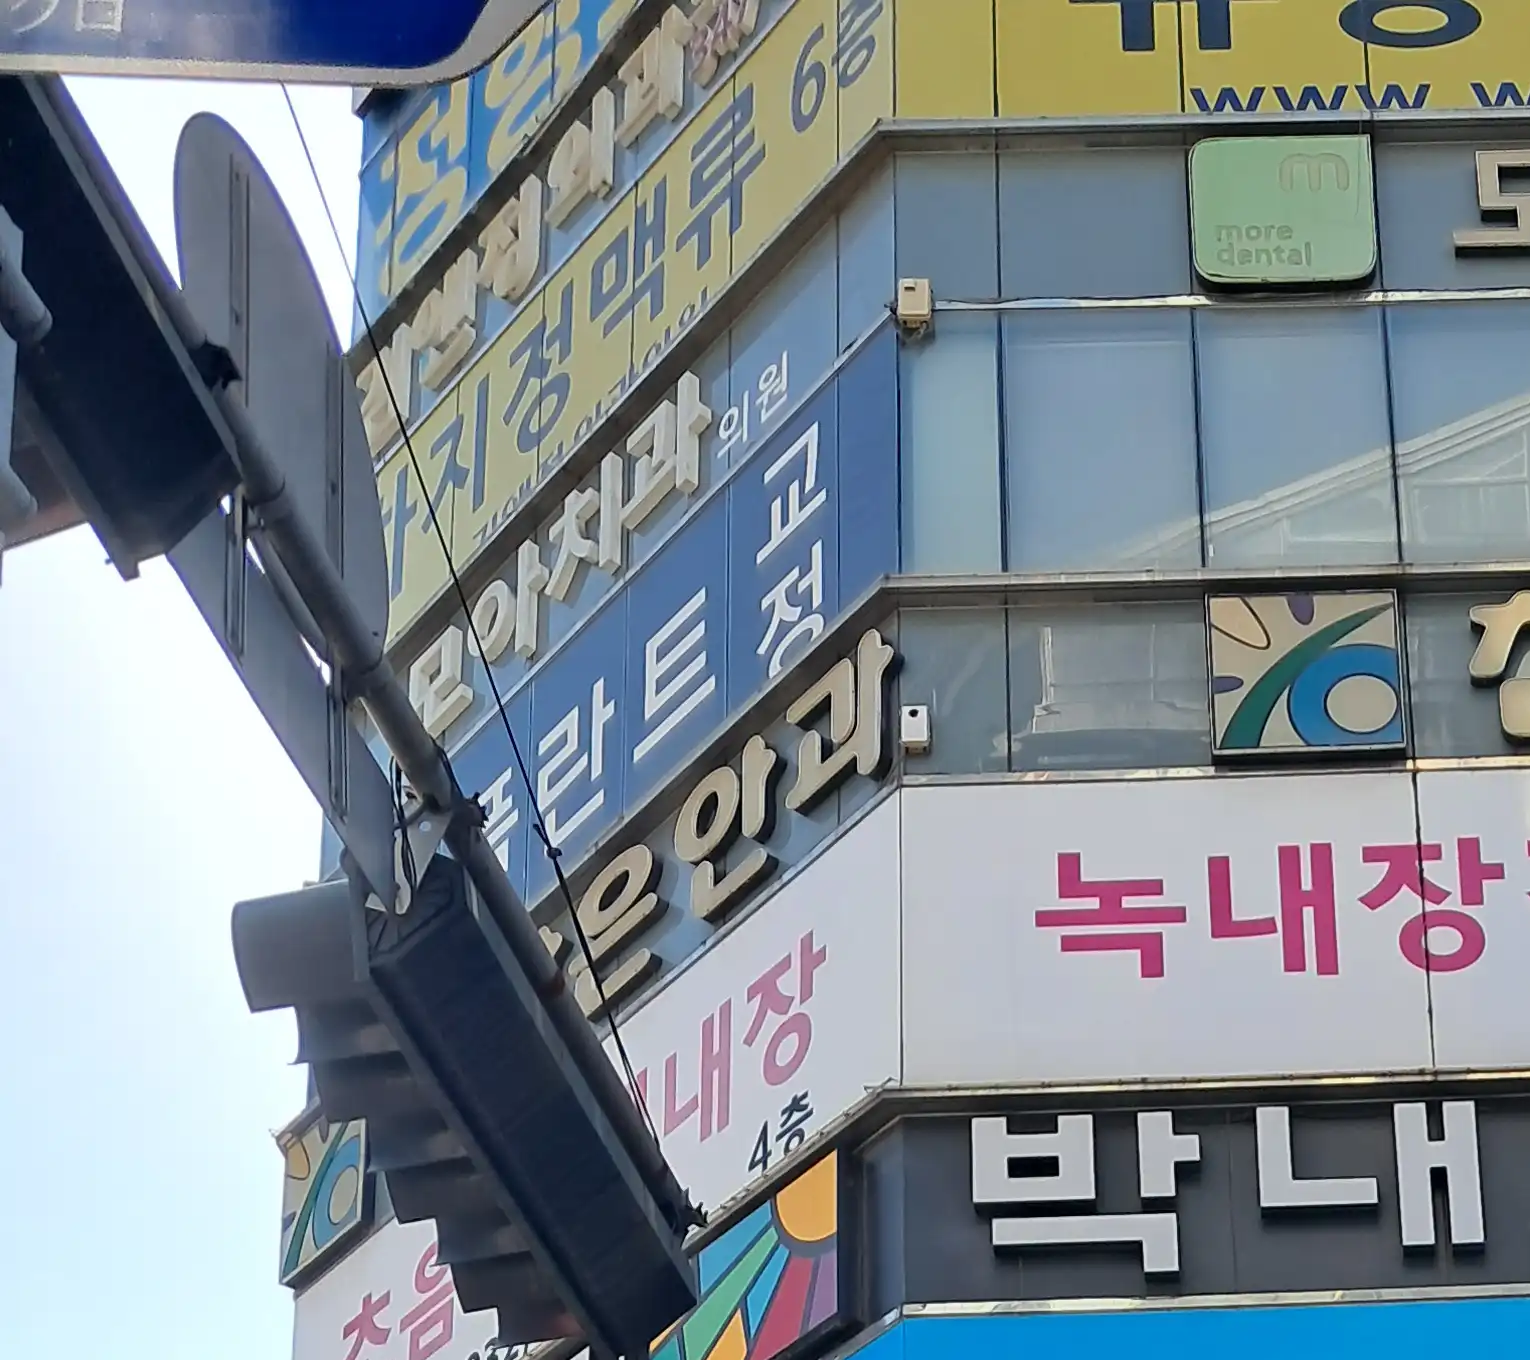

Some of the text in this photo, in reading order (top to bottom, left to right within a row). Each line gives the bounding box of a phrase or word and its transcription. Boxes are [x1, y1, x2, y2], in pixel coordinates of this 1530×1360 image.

[1215, 224, 1293, 243] more
[1216, 242, 1313, 267] dental
[408, 368, 713, 738] 모아치과
[716, 350, 790, 460] 의원
[748, 1090, 814, 1177] 4층
